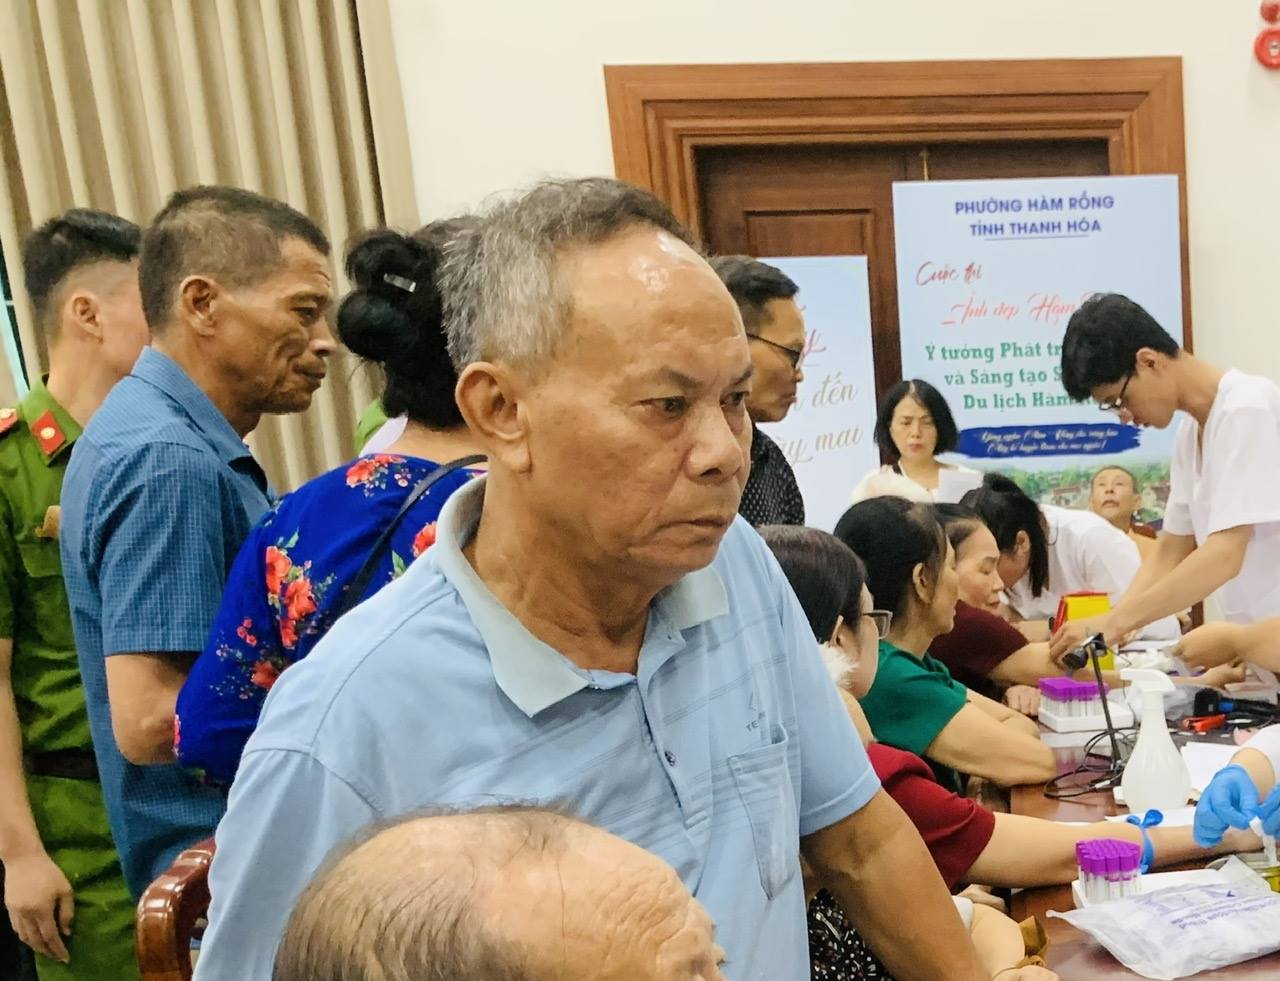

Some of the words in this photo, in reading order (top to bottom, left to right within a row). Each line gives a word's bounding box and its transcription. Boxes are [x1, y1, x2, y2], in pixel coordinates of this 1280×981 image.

[955, 197, 1023, 215] PHƯỜNG
[1028, 195, 1063, 212] HÀM
[1009, 221, 1061, 235] THANH
[1067, 217, 1101, 233] HÓA
[915, 261, 959, 286] Cuộc
[964, 261, 983, 284] thi
[1000, 341, 1042, 358] Phát
[944, 369, 965, 386] và
[970, 368, 1013, 388] Sáng
[1019, 369, 1047, 387] tạo
[963, 394, 987, 409] Du
[993, 392, 1026, 412] lịch
[816, 425, 863, 451] mai
